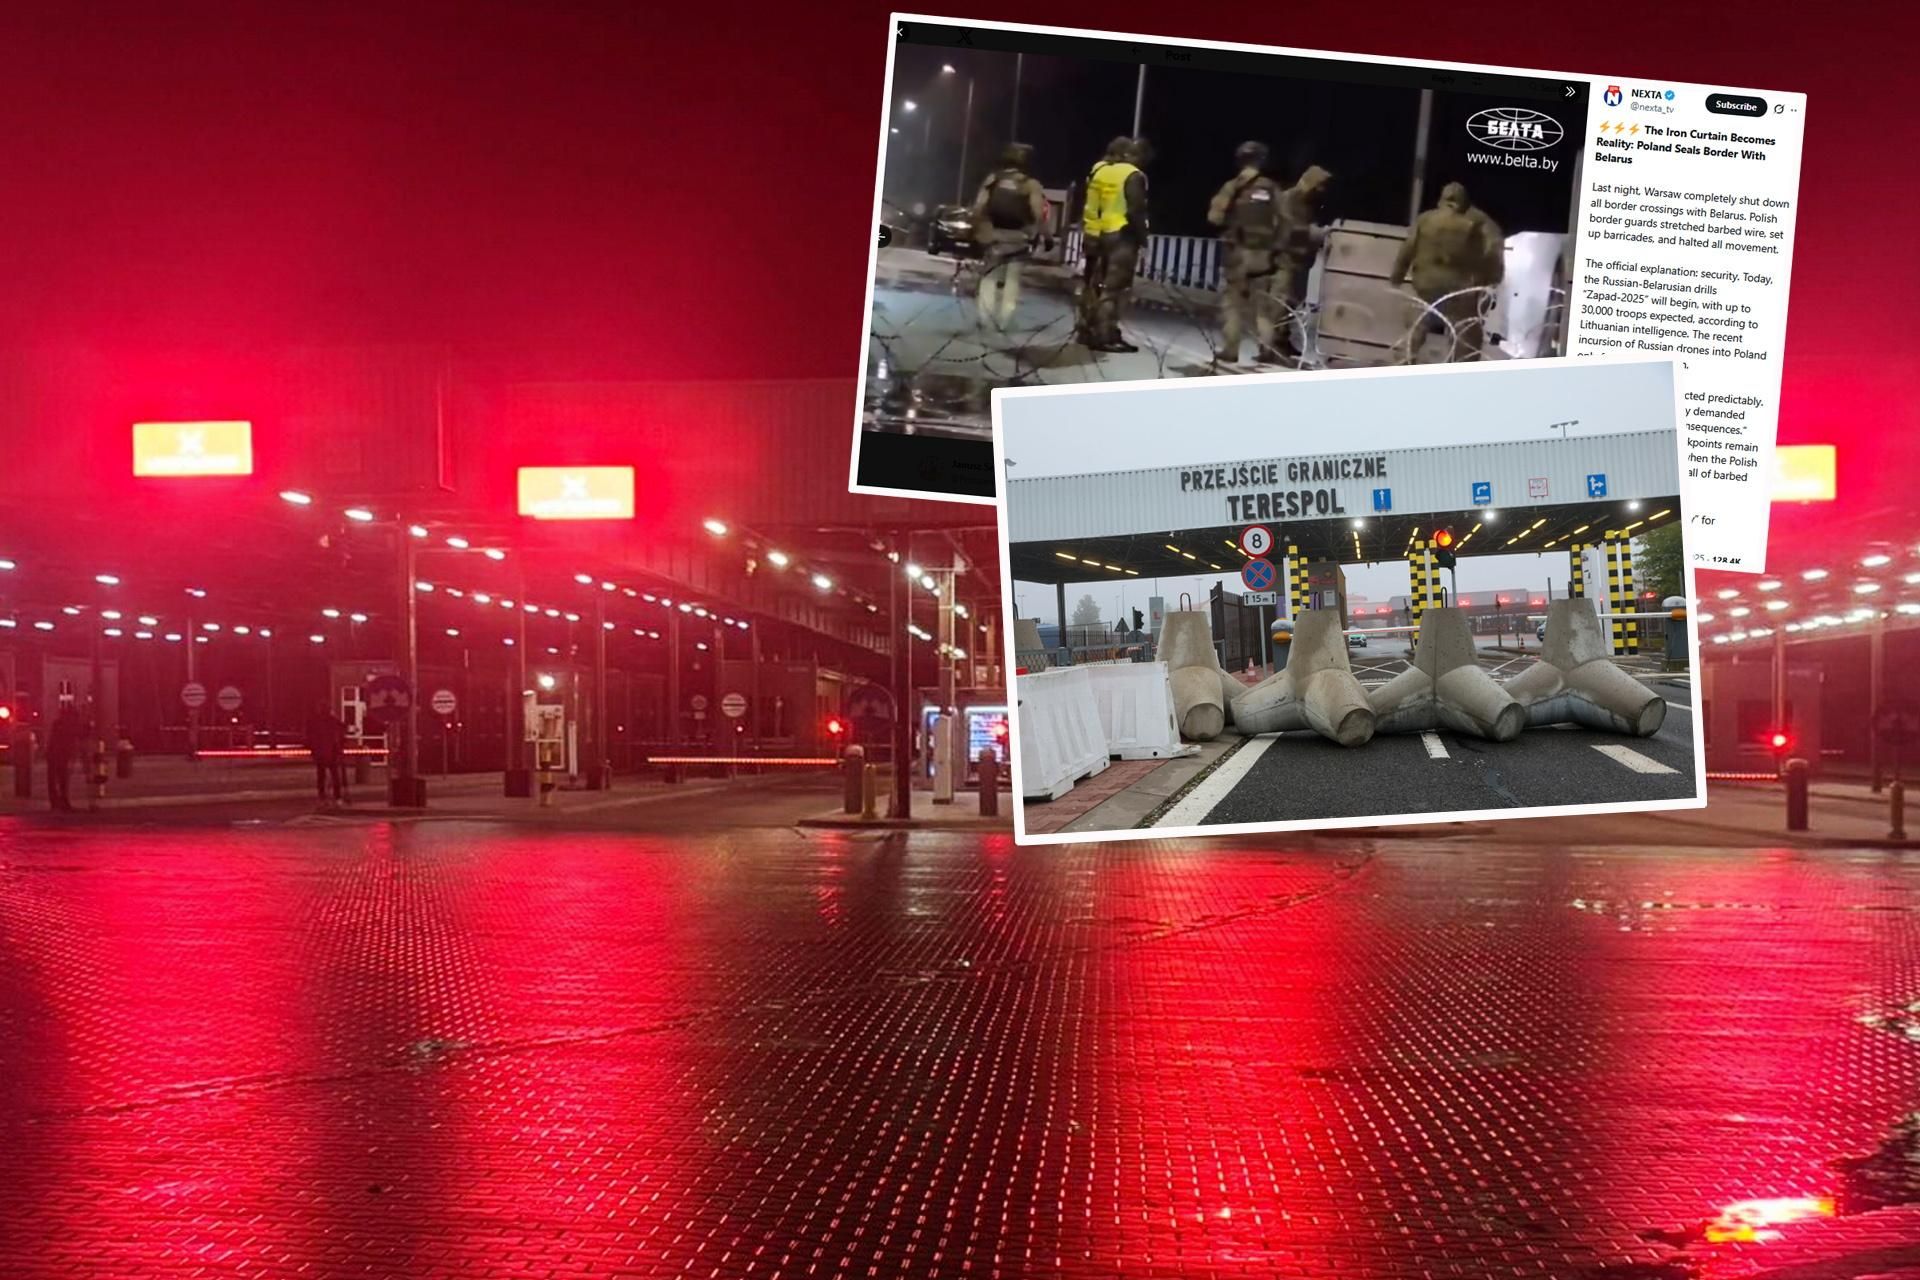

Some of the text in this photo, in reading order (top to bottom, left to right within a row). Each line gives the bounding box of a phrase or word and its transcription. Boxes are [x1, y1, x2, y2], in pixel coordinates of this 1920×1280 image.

[1181, 457, 1387, 491] PRZEJŚCIE GRANICZNE
[1227, 488, 1345, 521] TERESPOL
[1252, 533, 1262, 549] 8
[1252, 593, 1262, 603] 15
